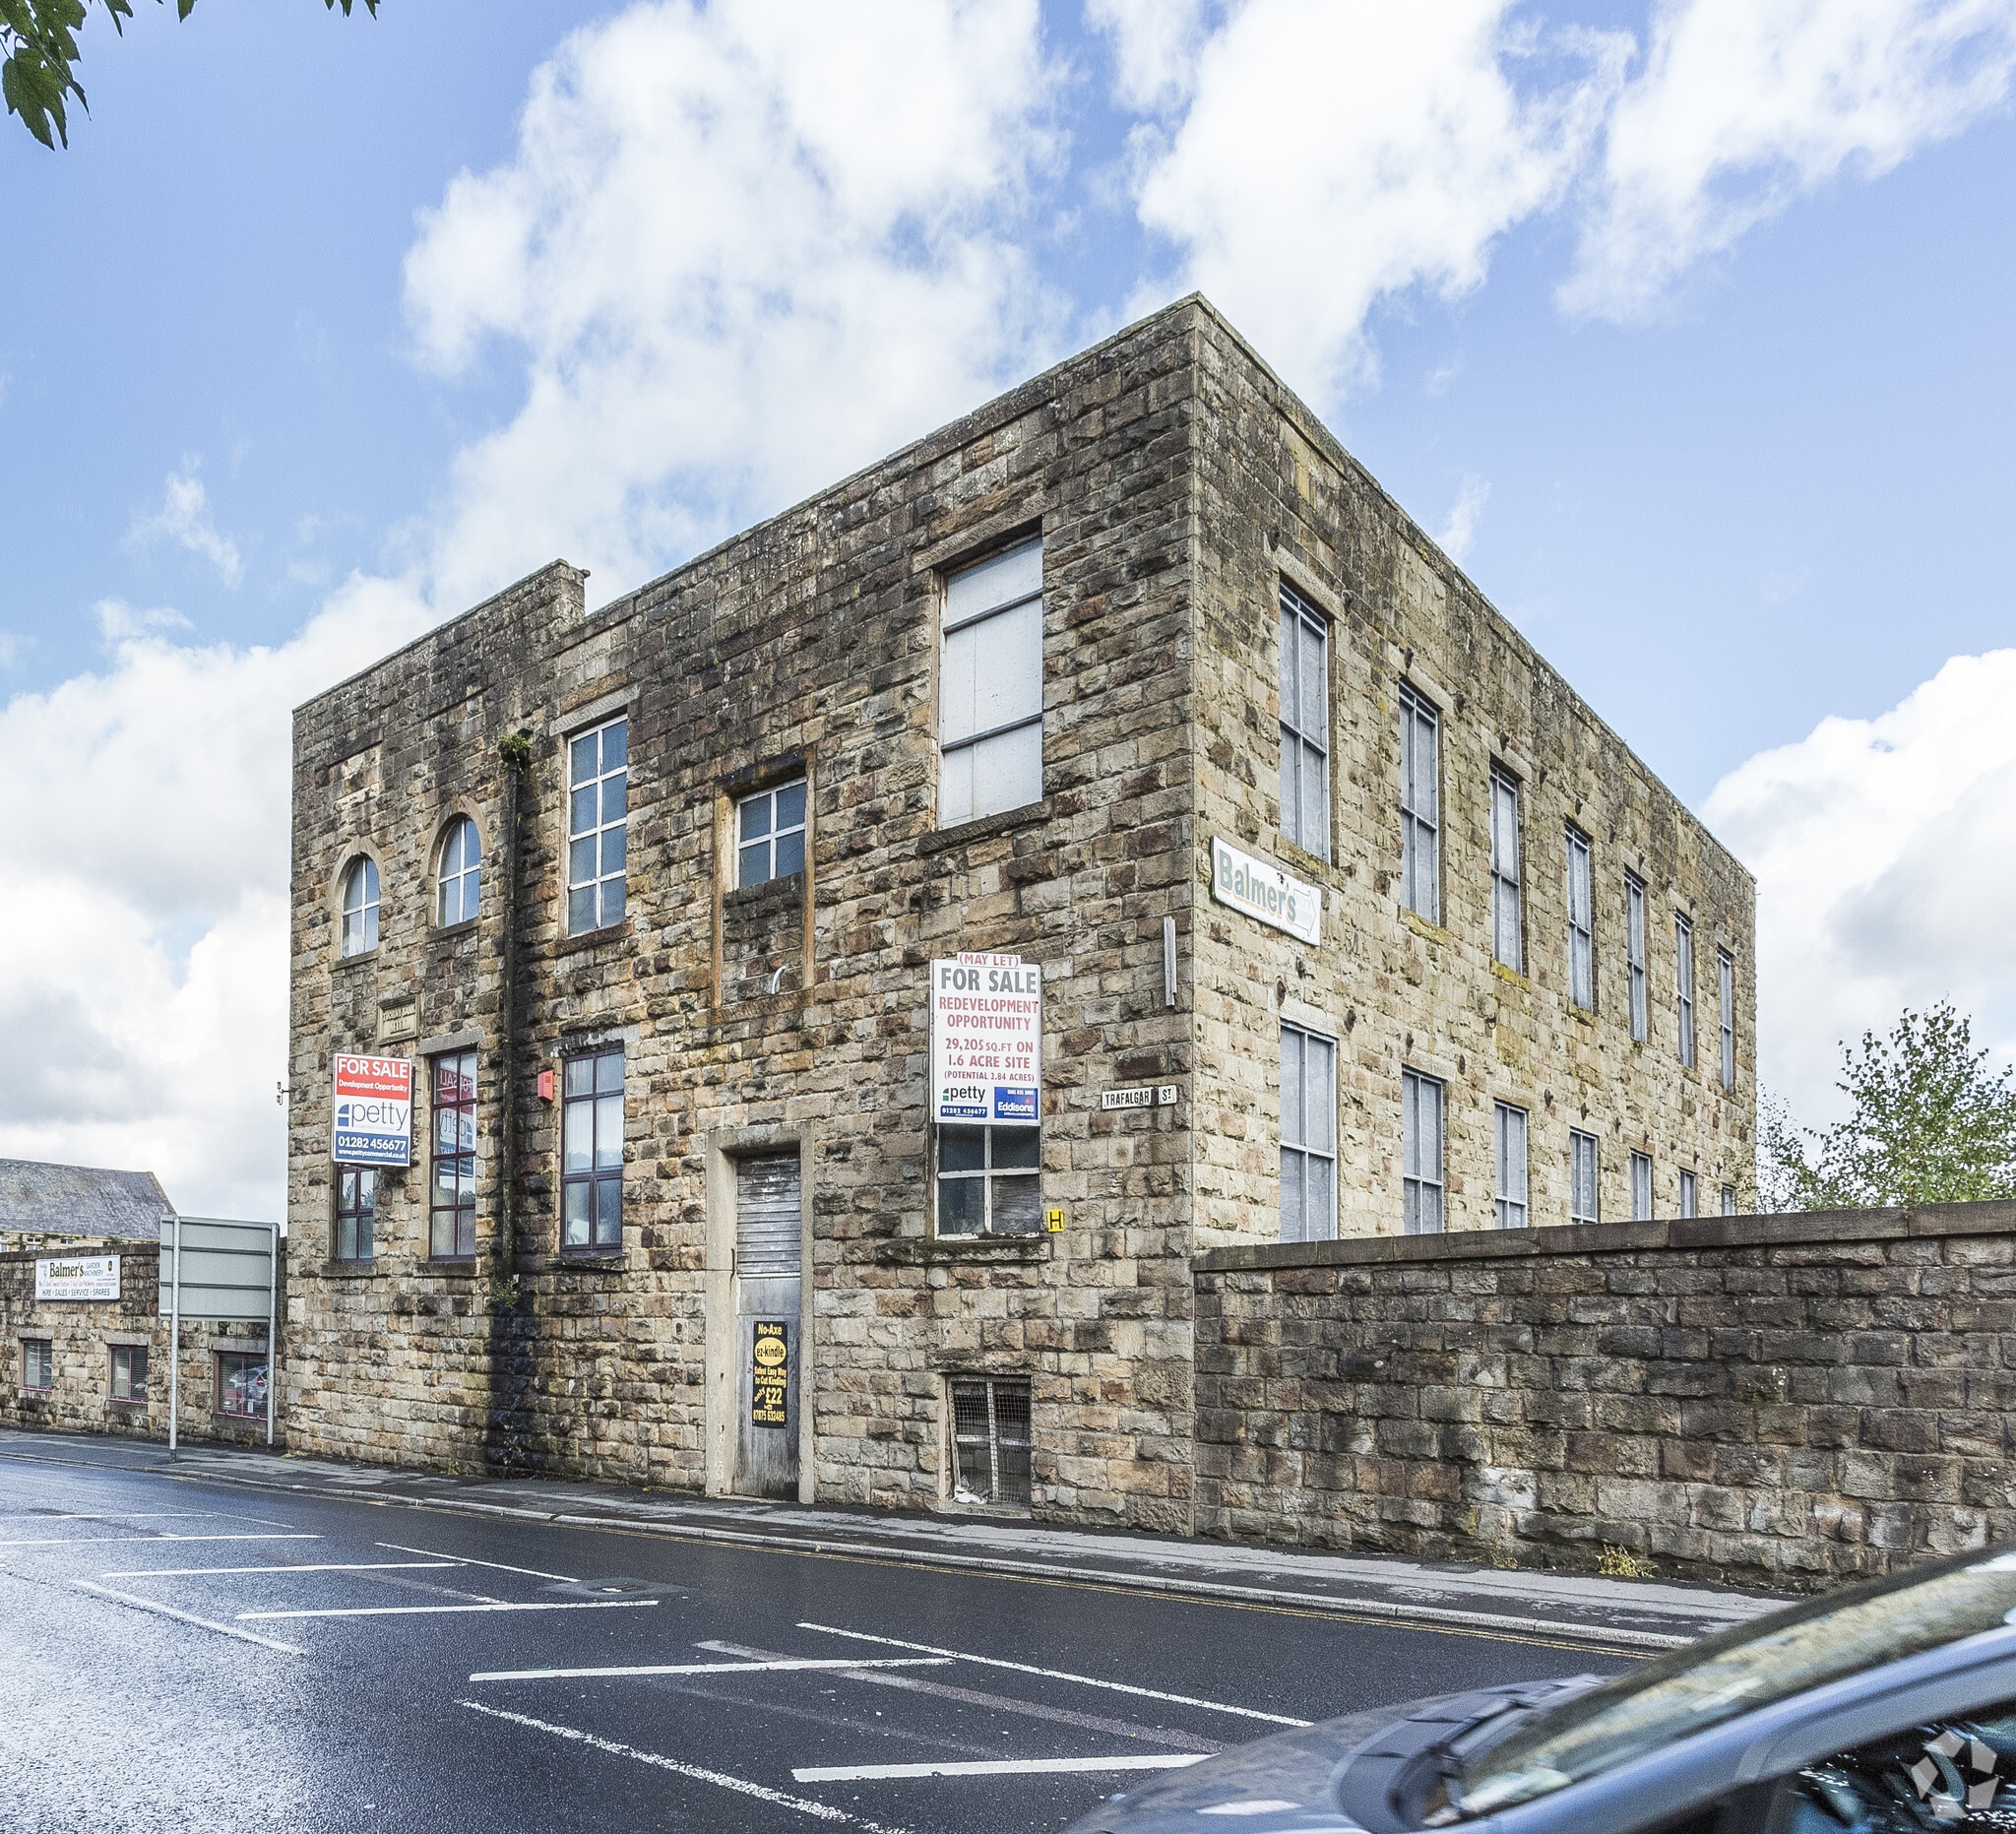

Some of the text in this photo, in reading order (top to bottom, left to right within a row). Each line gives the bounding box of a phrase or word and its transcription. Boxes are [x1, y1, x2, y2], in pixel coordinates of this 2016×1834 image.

[1219, 848, 1296, 922] Balmer's
[959, 952, 1019, 968] (MAY LET)
[941, 967, 1037, 994] FOR SALE
[939, 996, 1039, 1014] REDEVELOPMENT
[947, 1014, 1031, 1031] OPPORTUNITY
[945, 1038, 1034, 1053] 29,205 SQ.FT ON
[338, 1057, 409, 1079] FOR SALE
[948, 1053, 1030, 1069] 1.6 ACRE SITE
[944, 1070, 1035, 1082] (POTENTIAL 2.84 ACRES)
[339, 1079, 409, 1094] Development Opportunity
[951, 1086, 985, 1104] petty
[1104, 1091, 1150, 1106] TRAFALGAR
[997, 1102, 1035, 1112] Eddisons
[351, 1101, 409, 1132] petty
[338, 1135, 407, 1151] 01282 456677
[338, 1149, 407, 1160] www.pettycommercial.co.uk
[1049, 1211, 1062, 1230] H
[49, 1262, 84, 1278] Balmer's
[93, 1288, 110, 1296] SPARES
[757, 1323, 783, 1336] No-Axe
[756, 1345, 785, 1358] ez-kindle
[765, 1387, 783, 1405] £22
